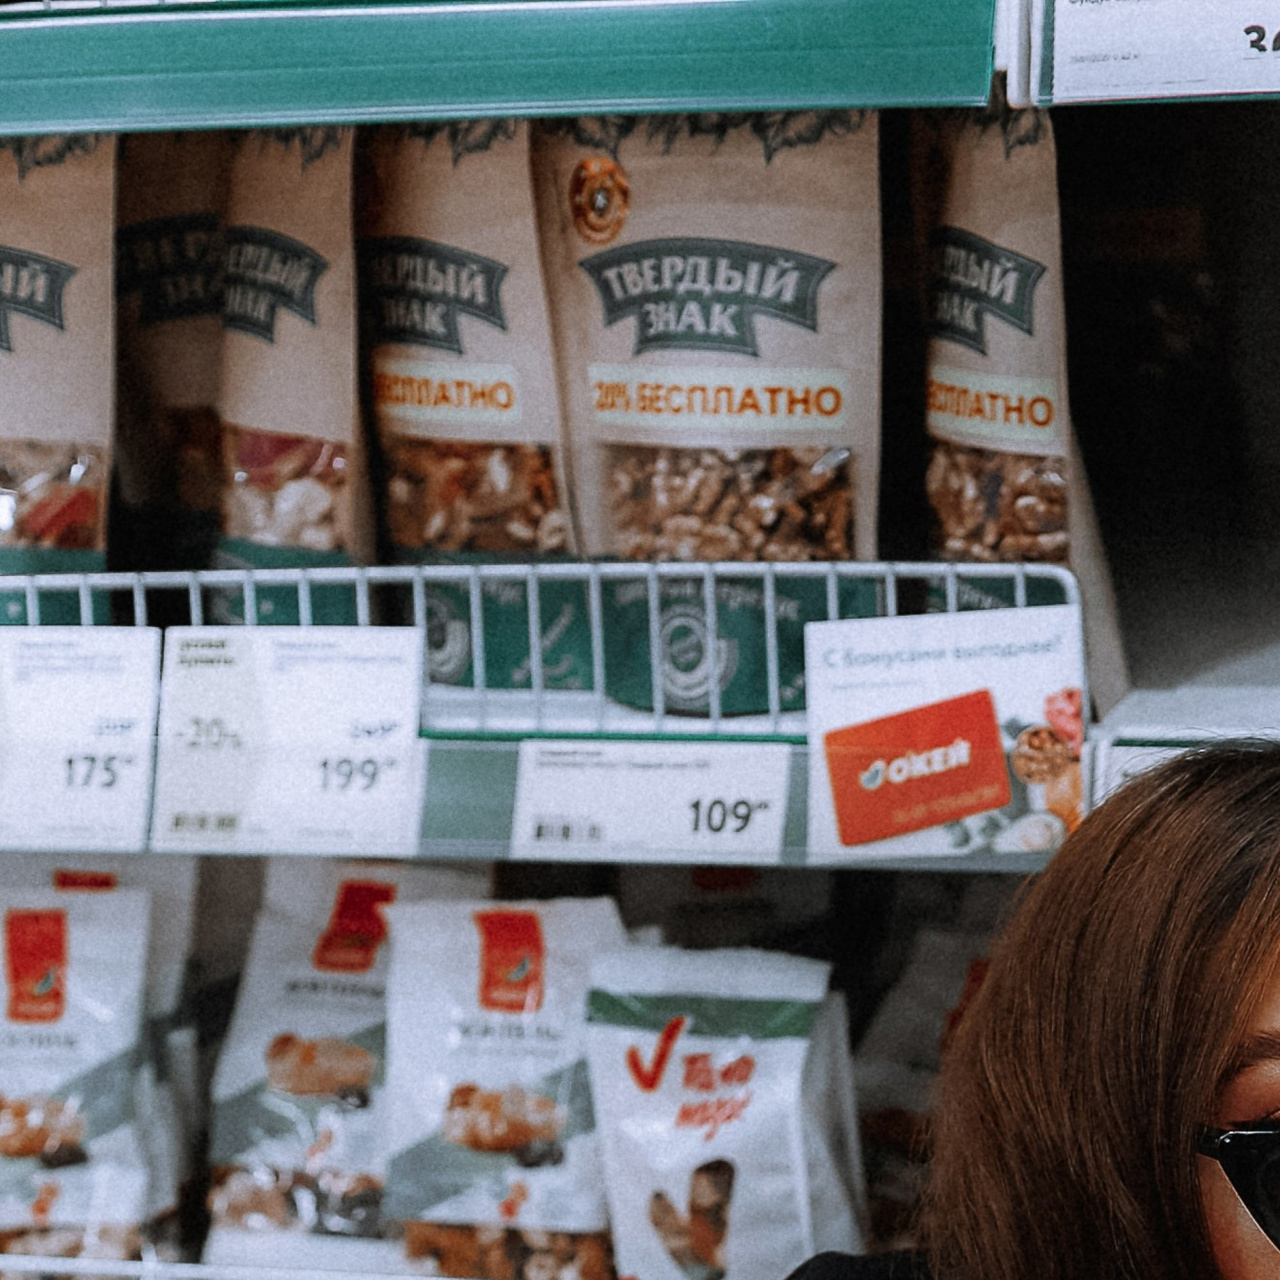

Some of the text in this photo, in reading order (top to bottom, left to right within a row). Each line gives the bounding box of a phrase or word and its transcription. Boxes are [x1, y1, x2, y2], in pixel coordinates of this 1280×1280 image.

[603, 255, 800, 303] ТВЕРДЫЙ
[641, 300, 739, 337] ЗНАК
[637, 383, 842, 417] БЕСПЛАТНО
[66, 756, 117, 788] 175
[320, 757, 380, 791] 199
[690, 799, 752, 833] 109
